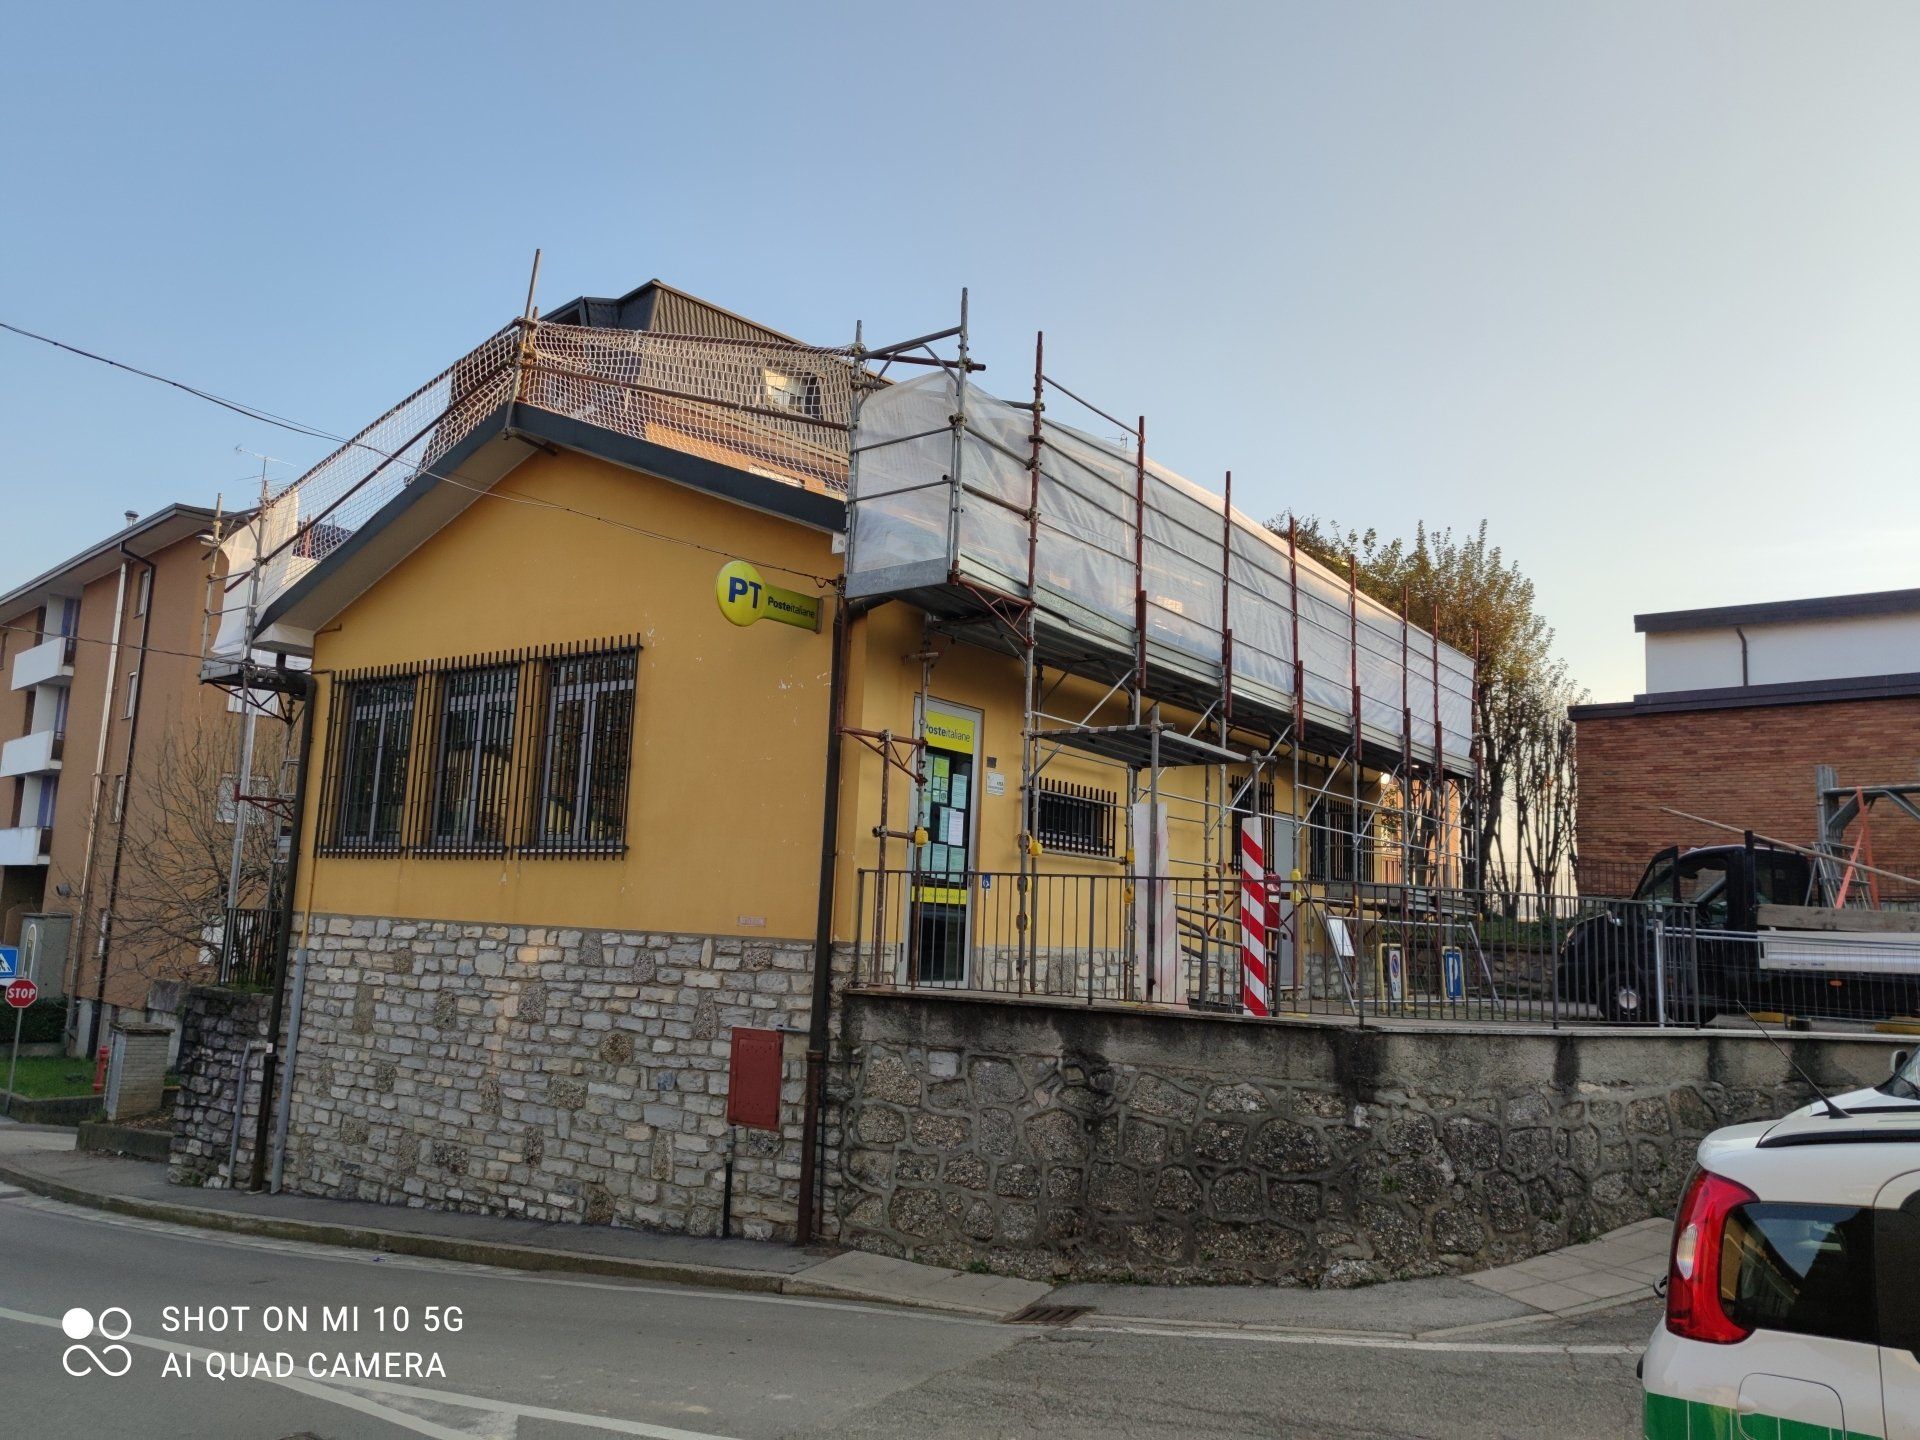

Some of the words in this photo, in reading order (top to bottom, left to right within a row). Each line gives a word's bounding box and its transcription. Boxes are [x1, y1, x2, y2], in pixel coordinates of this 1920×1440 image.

[728, 576, 762, 609] PT
[767, 595, 816, 619] Posteitaliane
[7, 987, 36, 999] STOP
